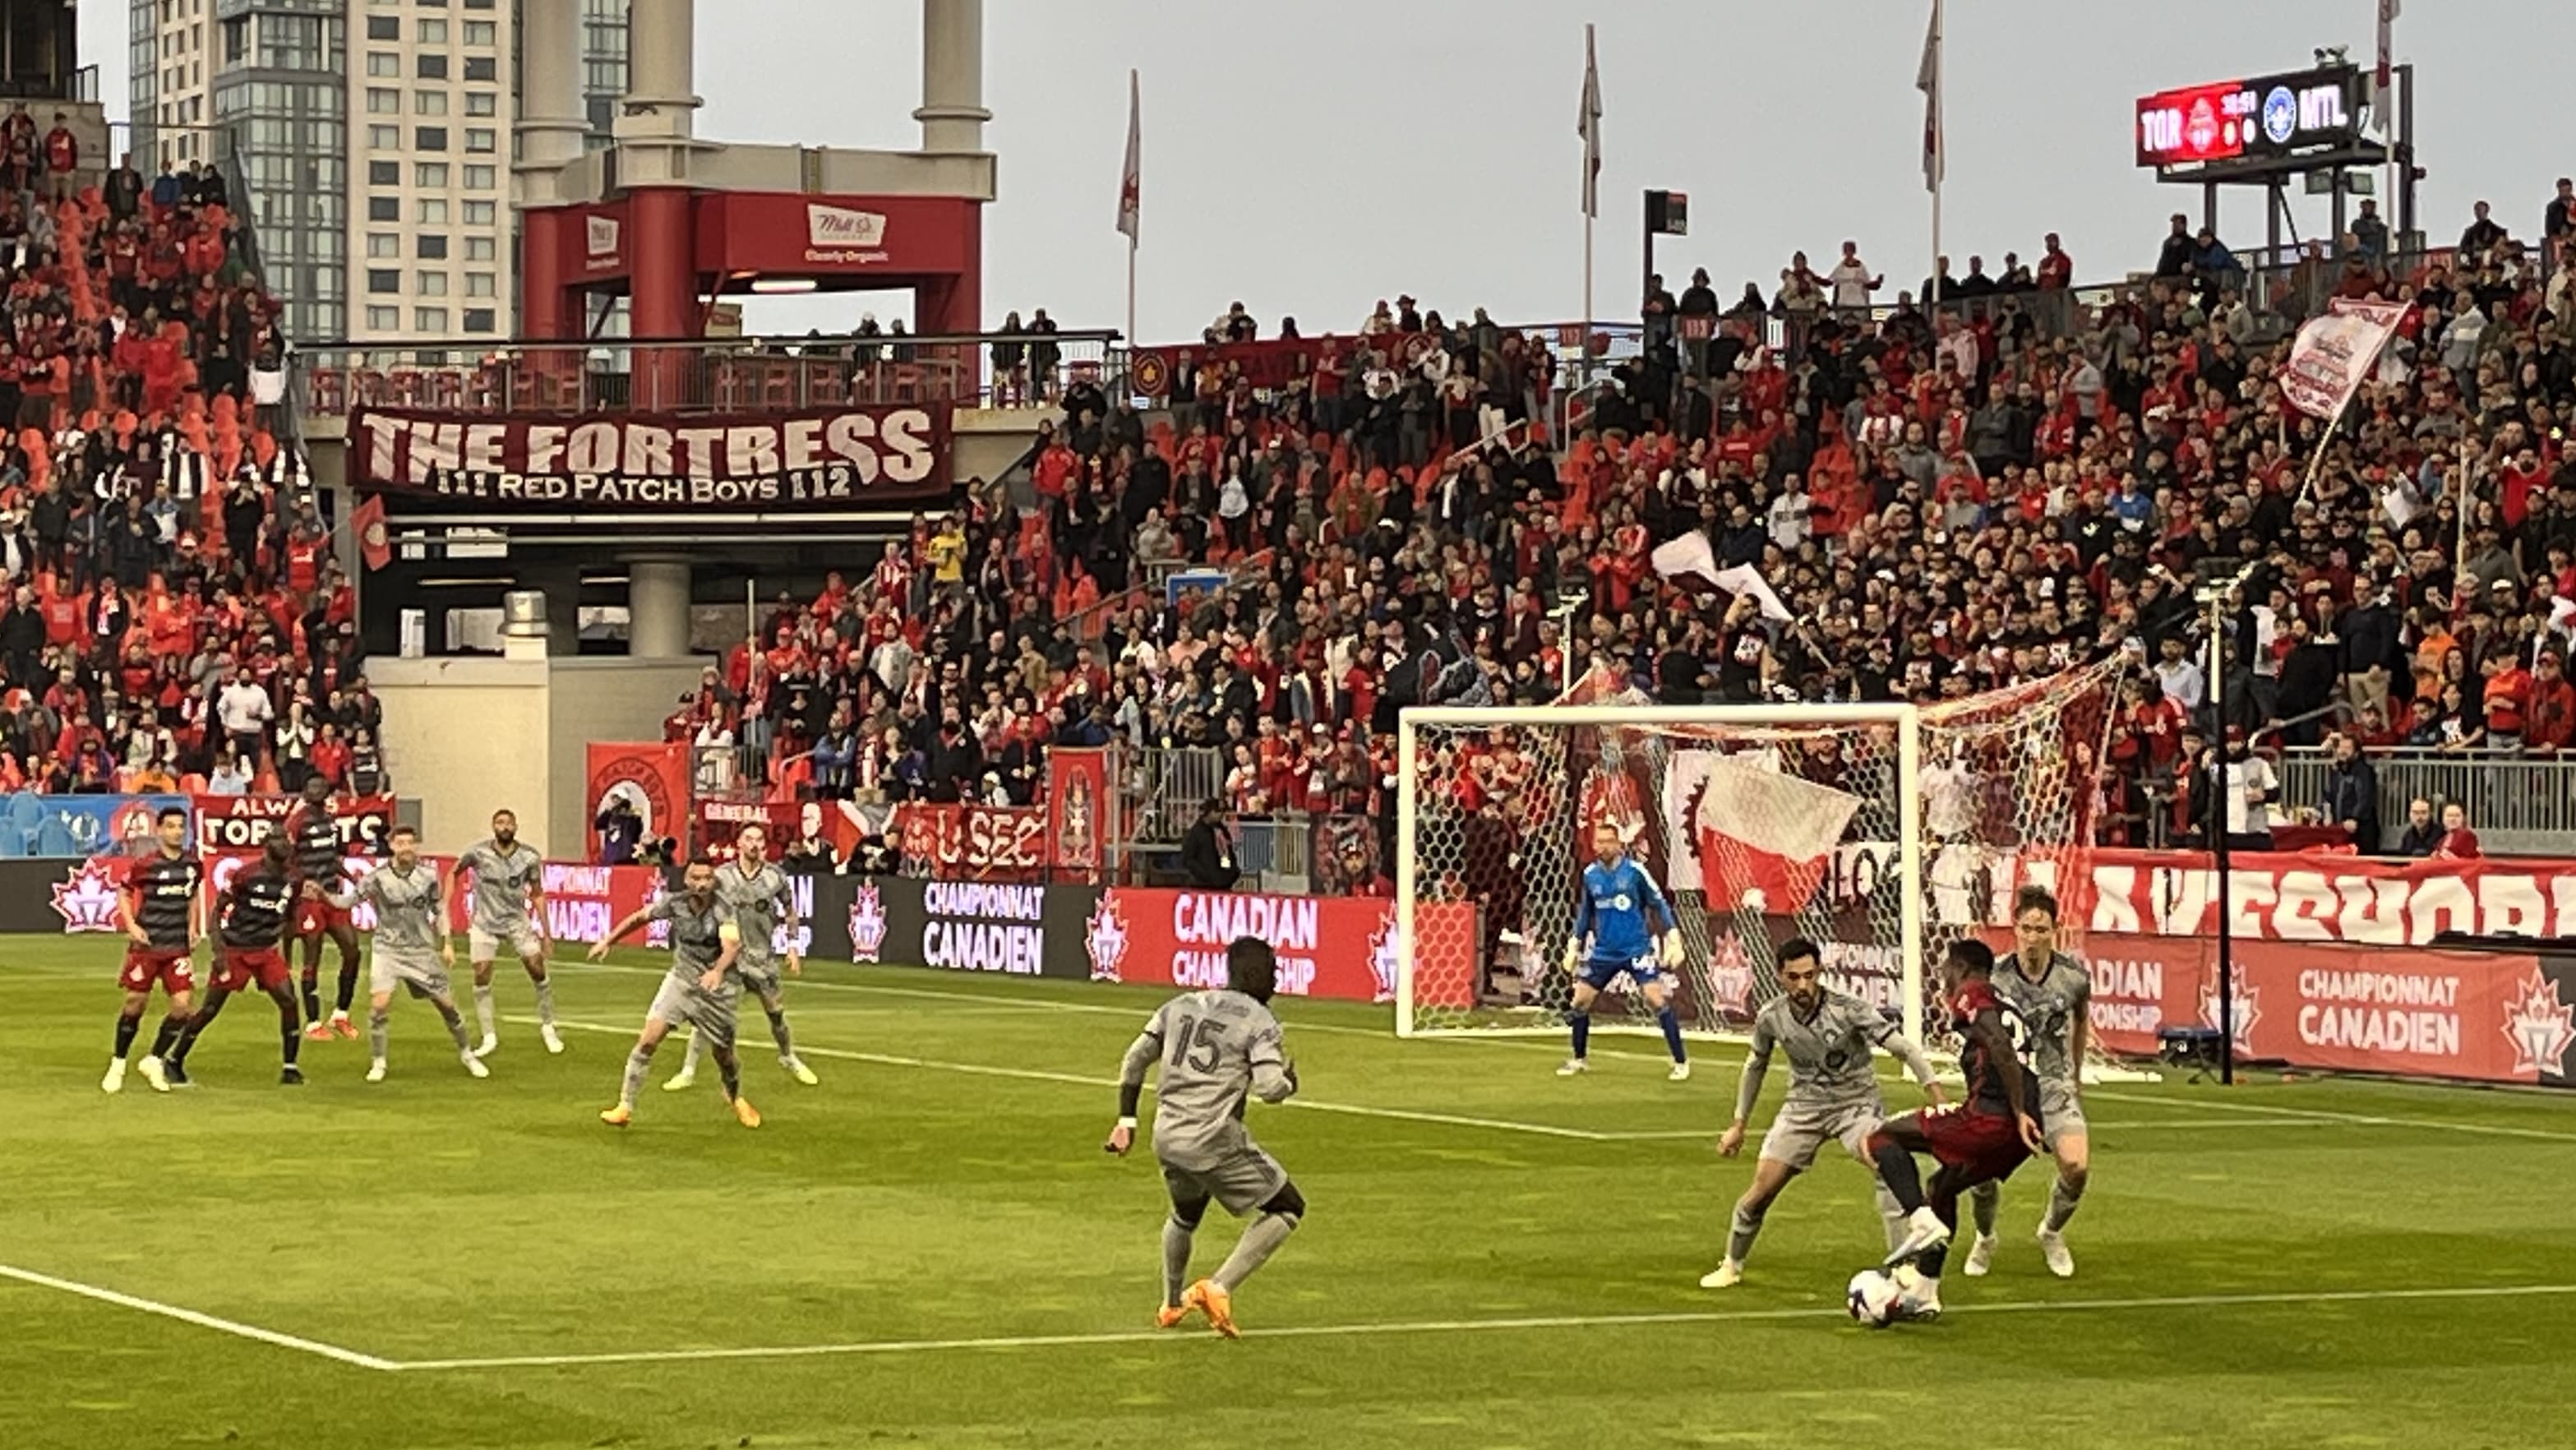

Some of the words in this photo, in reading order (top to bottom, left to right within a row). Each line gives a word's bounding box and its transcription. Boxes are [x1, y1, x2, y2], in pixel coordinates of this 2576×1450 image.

[2140, 108, 2182, 152] TOR
[2299, 85, 2348, 130] MTL
[2242, 118, 2255, 144] 0
[362, 413, 507, 485] THE
[527, 409, 935, 485] FORTRESS
[437, 467, 487, 496] 111
[498, 473, 568, 499] RED
[575, 473, 684, 501] PATCH
[690, 476, 780, 503] BOYS
[790, 466, 851, 499] 112
[923, 882, 1046, 921] CHAMPIONNAT
[1174, 893, 1318, 950] CANADIAN
[922, 921, 1044, 976] CANADIEN
[1172, 950, 1316, 996] CHAMSHIP
[2298, 968, 2461, 1006] CHAMPIONNAT
[1170, 1014, 1227, 1074] 15
[2298, 1004, 2460, 1055] CANADIEN
